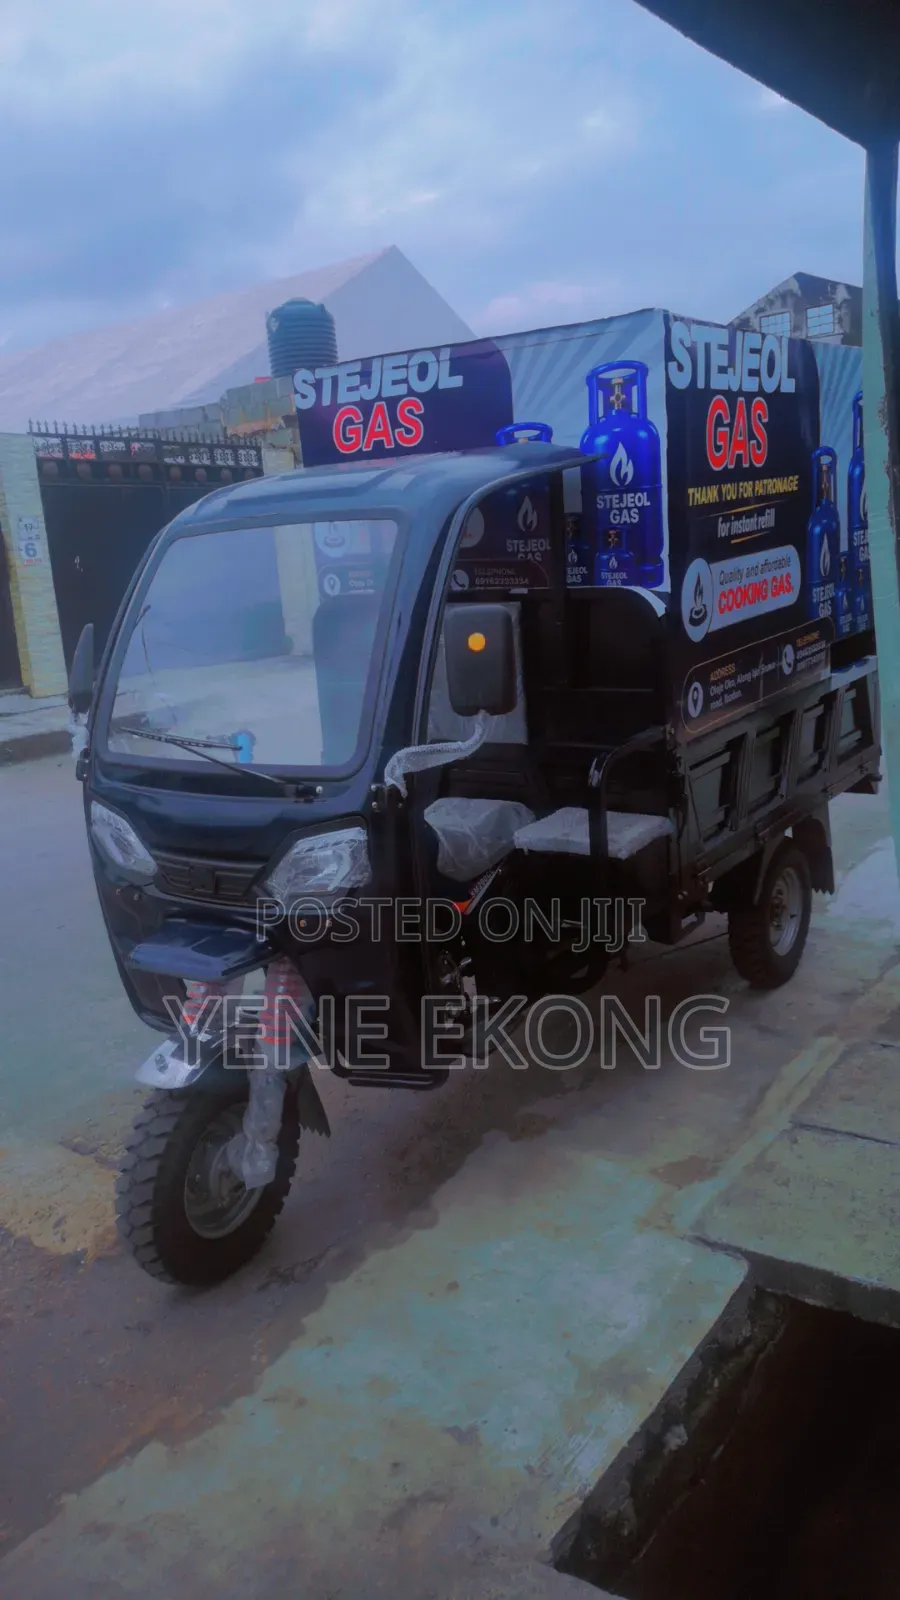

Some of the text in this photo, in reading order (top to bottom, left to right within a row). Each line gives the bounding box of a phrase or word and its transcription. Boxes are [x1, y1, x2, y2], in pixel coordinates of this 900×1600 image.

[668, 321, 796, 394] STEJEOL
[293, 348, 463, 410] STEJEOL
[333, 397, 425, 454] GAS
[706, 395, 769, 471] GAS
[596, 492, 651, 509] STEJEOL
[687, 475, 799, 507] THANK YOU FOR PATRONAGE
[609, 508, 640, 524] GAS
[717, 508, 775, 538] for instant refill
[24, 542, 38, 558] 6
[506, 538, 552, 553] STEJEOL
[600, 571, 628, 580] STEJEOL
[719, 554, 792, 586] Quality and affordable
[718, 578, 769, 614] COOKING
[709, 663, 736, 681] ADDRESS
